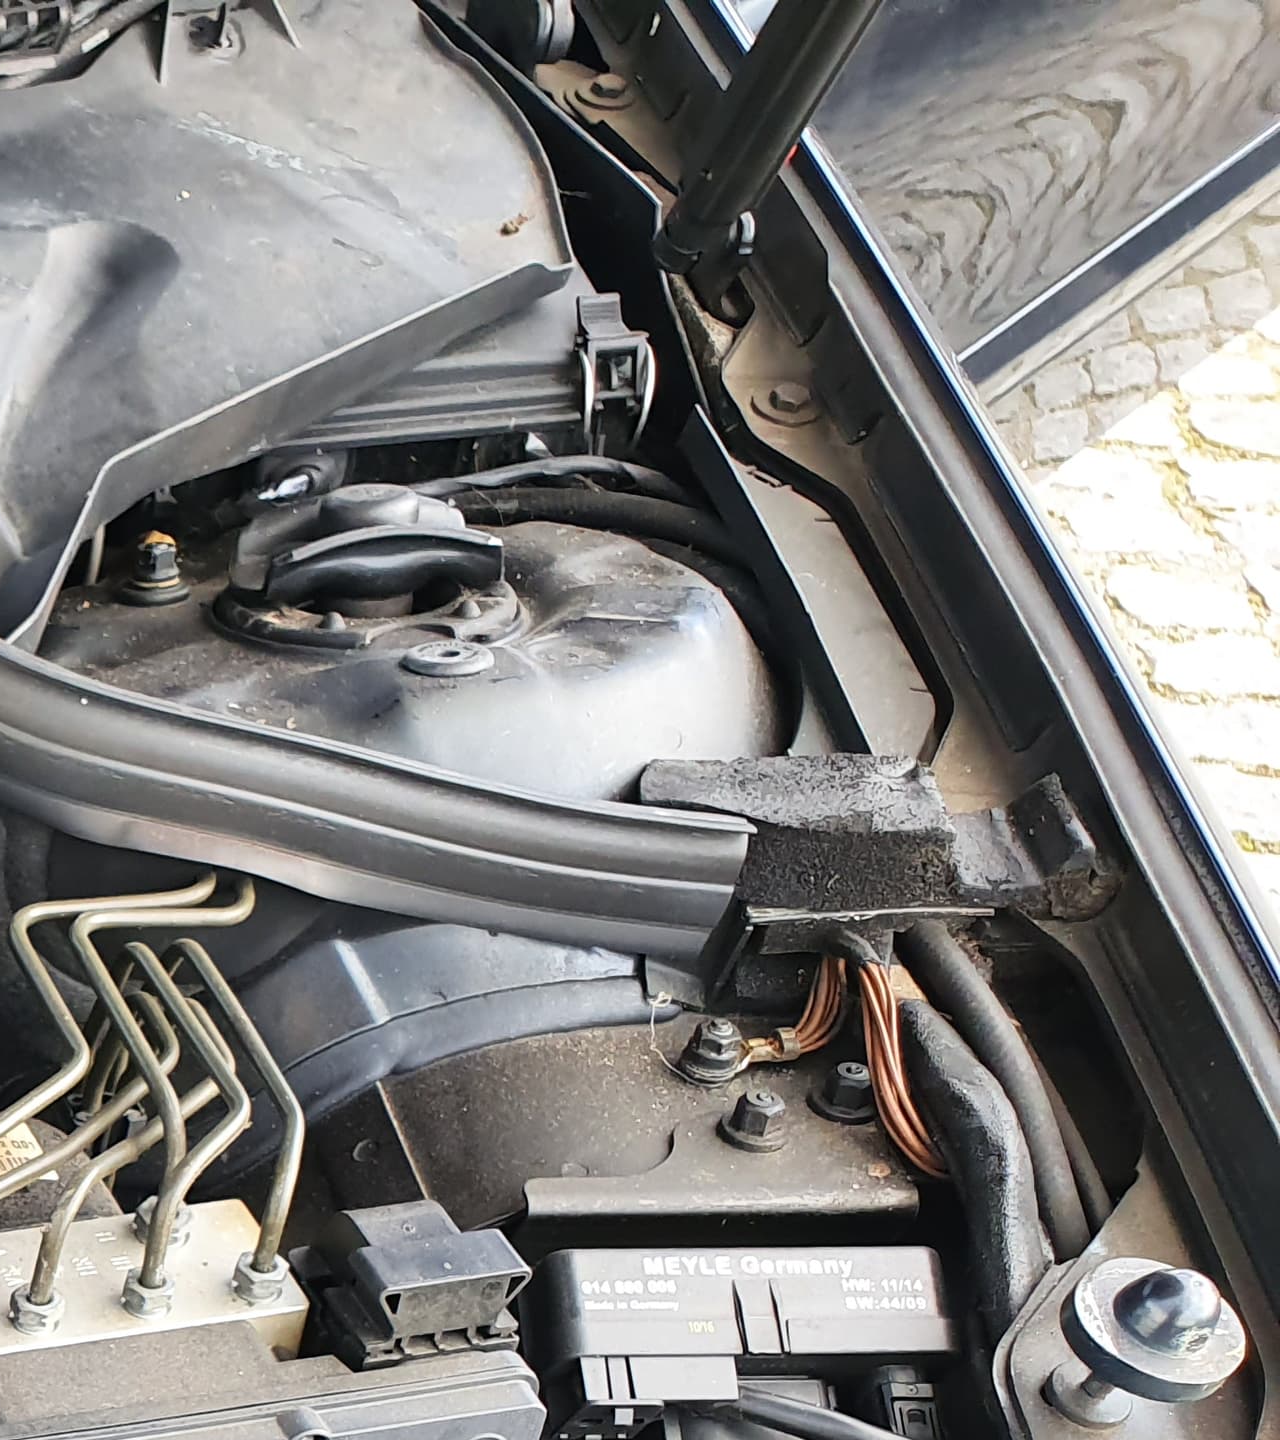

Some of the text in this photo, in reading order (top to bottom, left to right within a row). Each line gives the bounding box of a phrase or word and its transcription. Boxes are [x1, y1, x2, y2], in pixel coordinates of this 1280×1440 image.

[643, 1254, 853, 1278] MEYLE Germany
[841, 1278, 923, 1293] HW: 11/14
[629, 1301, 679, 1311] Germany
